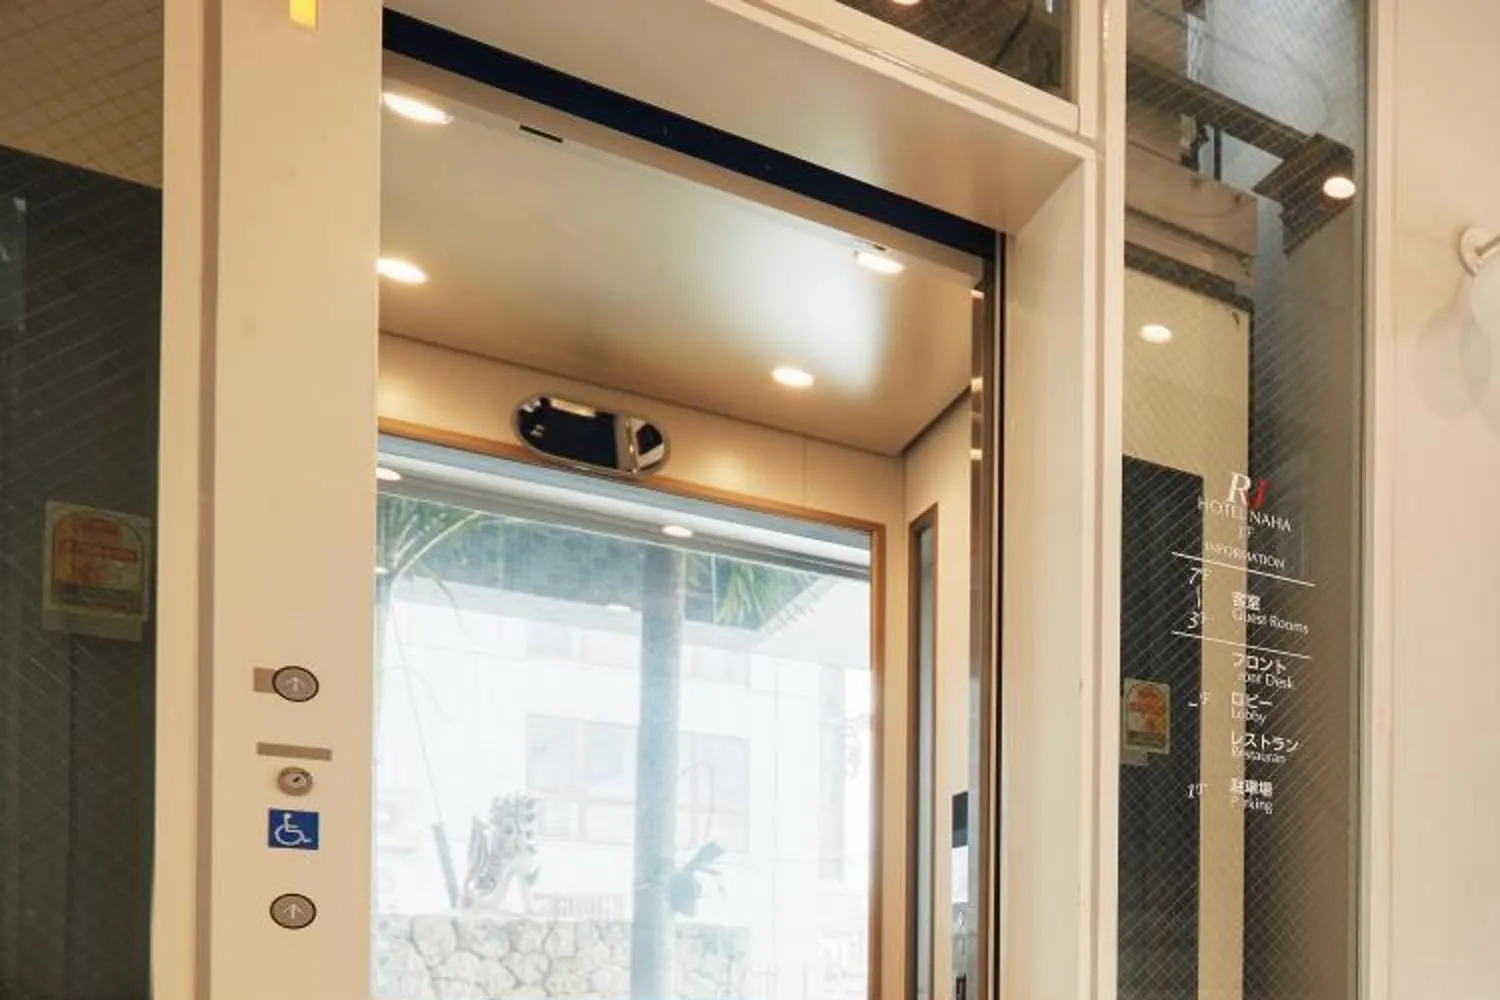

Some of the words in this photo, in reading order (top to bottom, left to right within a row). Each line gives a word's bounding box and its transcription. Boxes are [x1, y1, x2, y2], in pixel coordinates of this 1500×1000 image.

[1197, 497, 1247, 521] HOTEL
[1249, 511, 1292, 533] NAHA
[1269, 615, 1309, 635] Rooms
[1231, 652, 1288, 675] フロント
[1231, 691, 1273, 709] ロビー
[1231, 705, 1267, 727] Lobby
[1231, 730, 1299, 752] レストラン
[1231, 794, 1273, 815] Pking
